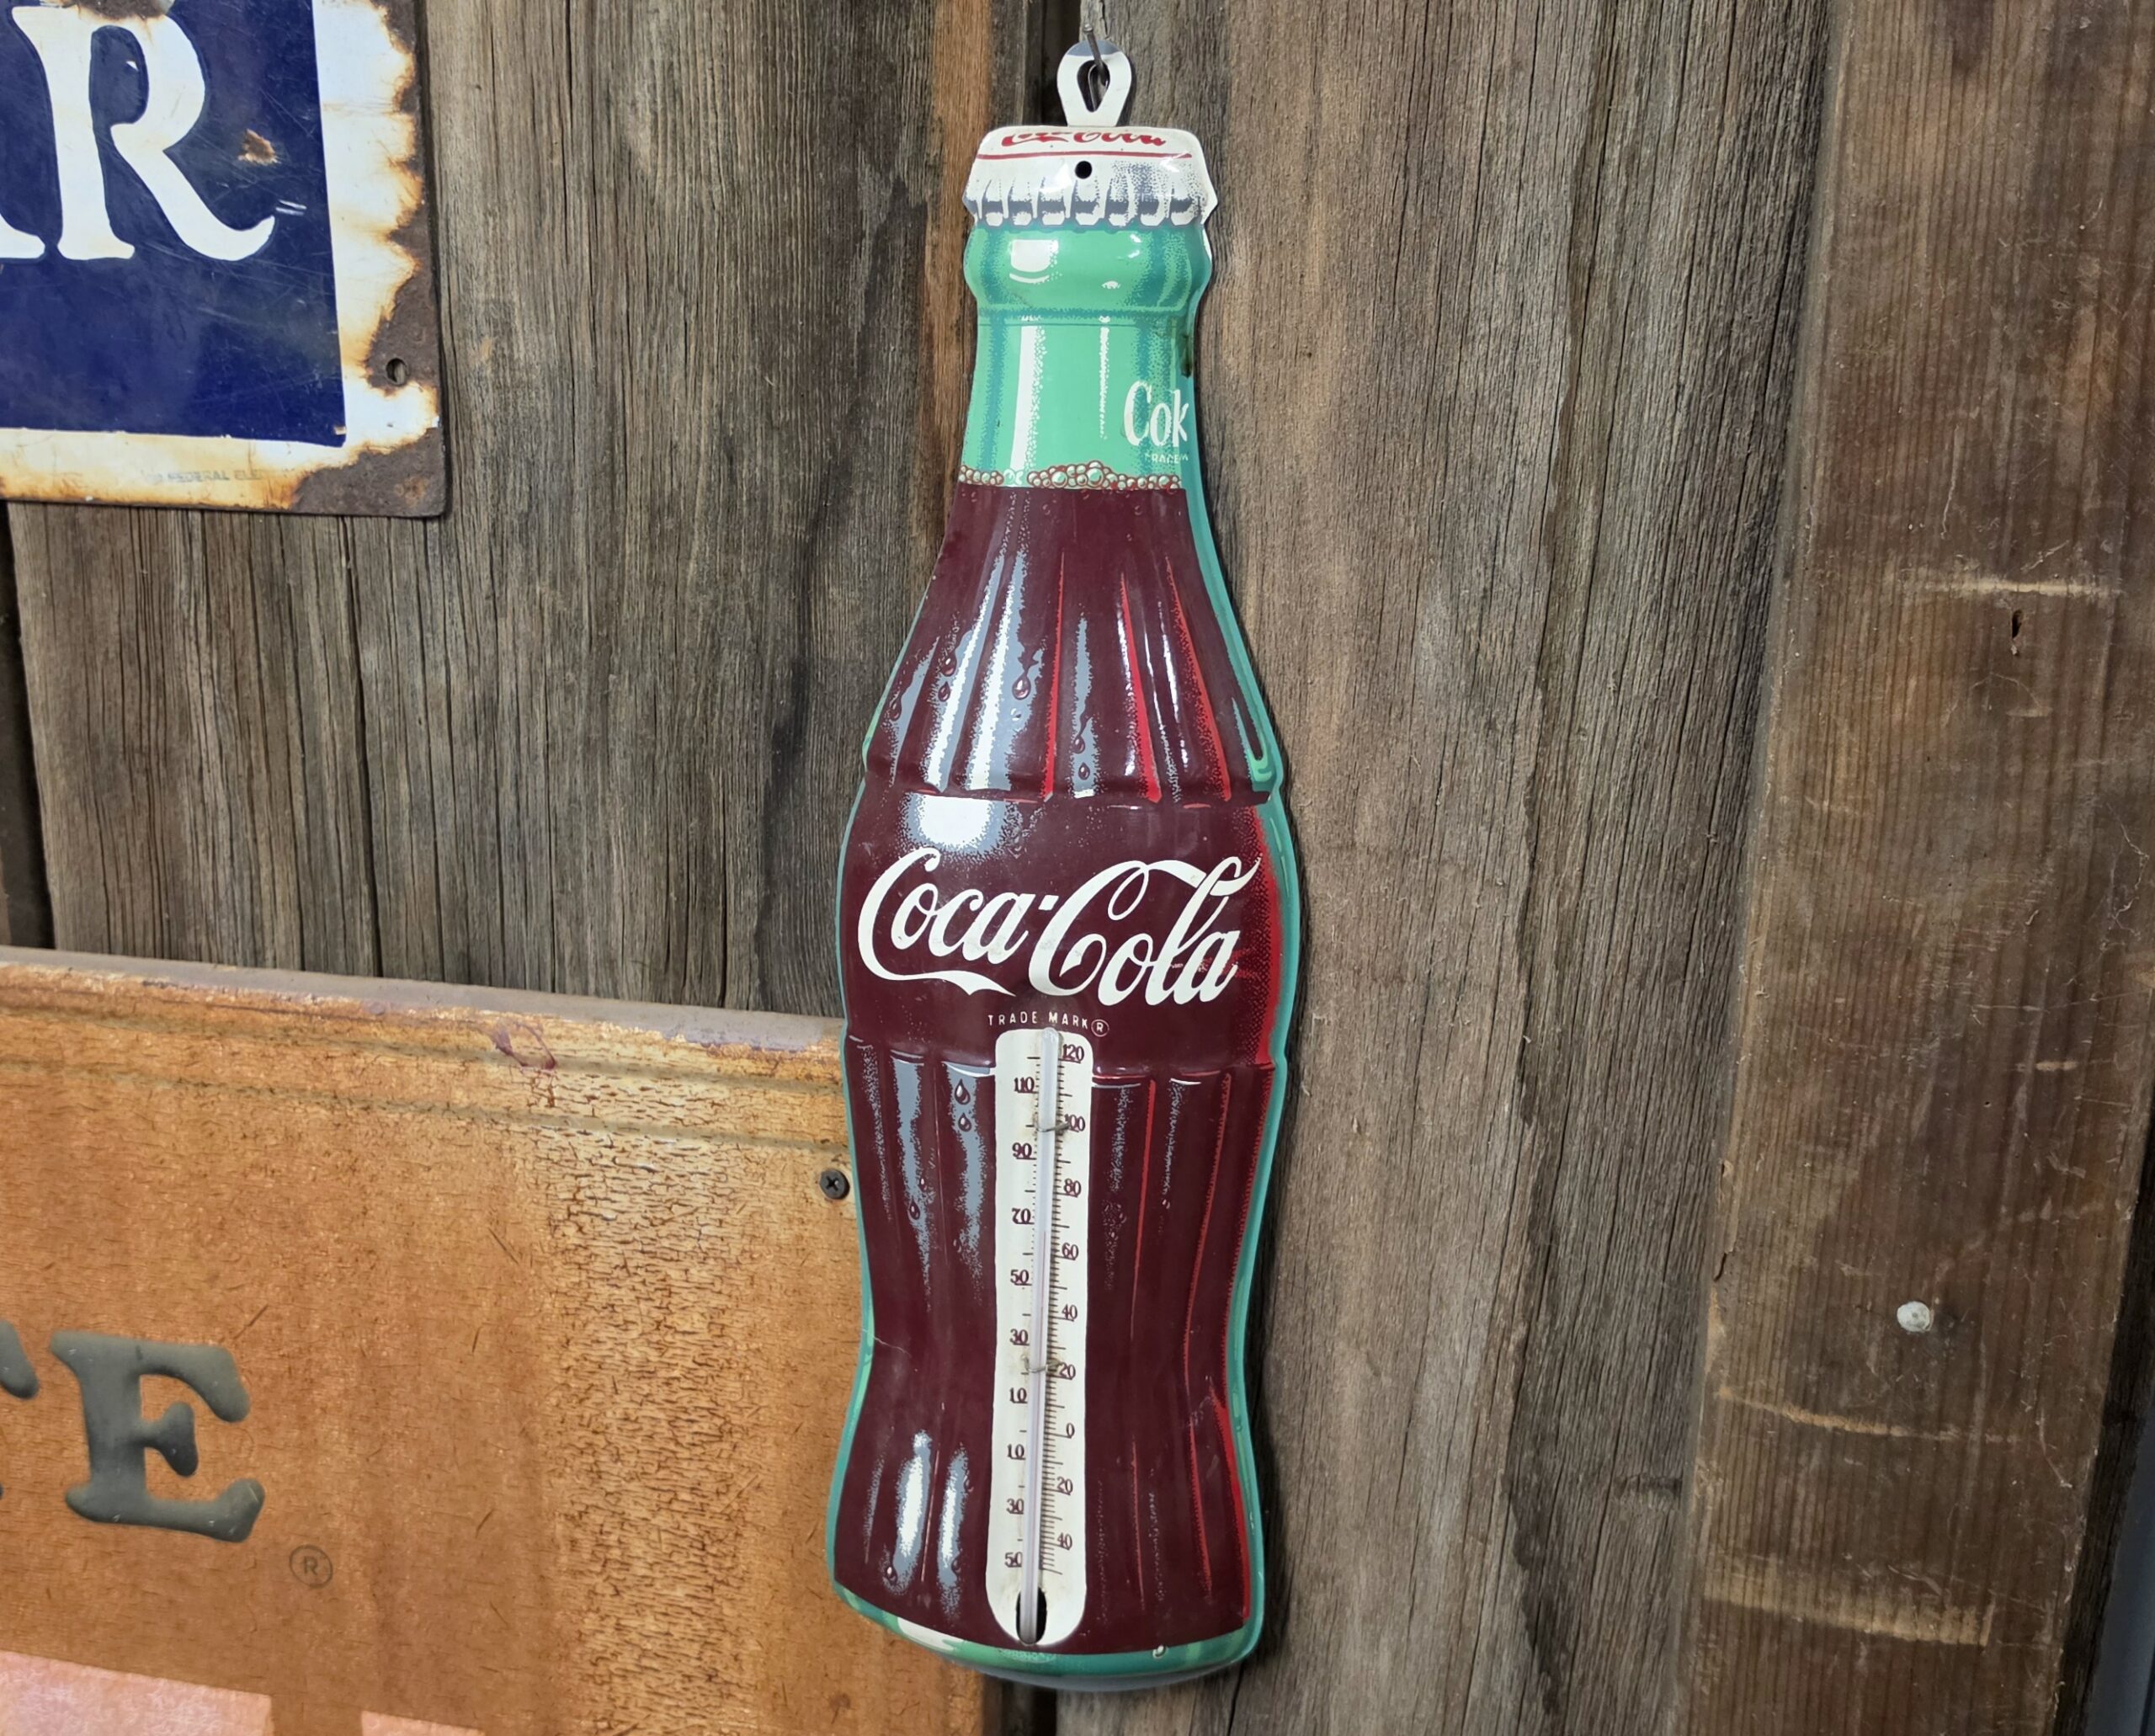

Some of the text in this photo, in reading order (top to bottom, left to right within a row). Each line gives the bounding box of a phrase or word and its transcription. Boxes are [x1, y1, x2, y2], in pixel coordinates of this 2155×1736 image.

[0, 4, 276, 261] R
[858, 847, 1263, 1007] Coca-Cola
[988, 1011, 1037, 1025] TRADE
[1063, 1044, 1084, 1062] 120
[1014, 1077, 1035, 1093] 110
[1013, 1142, 1032, 1158] 90
[1064, 1178, 1081, 1195] 80
[1012, 1208, 1031, 1223] 70
[1062, 1243, 1078, 1259] 60
[1010, 1270, 1029, 1285] 50
[1062, 1304, 1078, 1320] 40
[1009, 1329, 1028, 1345] 30
[1060, 1364, 1076, 1379] 20
[1009, 1388, 1027, 1403] 10
[1066, 1422, 1075, 1437] 0
[1008, 1445, 1024, 1460] 10
[1057, 1478, 1073, 1494] 20
[1007, 1499, 1024, 1514] 30
[1057, 1533, 1073, 1549] 40
[1004, 1552, 1022, 1567] 50
